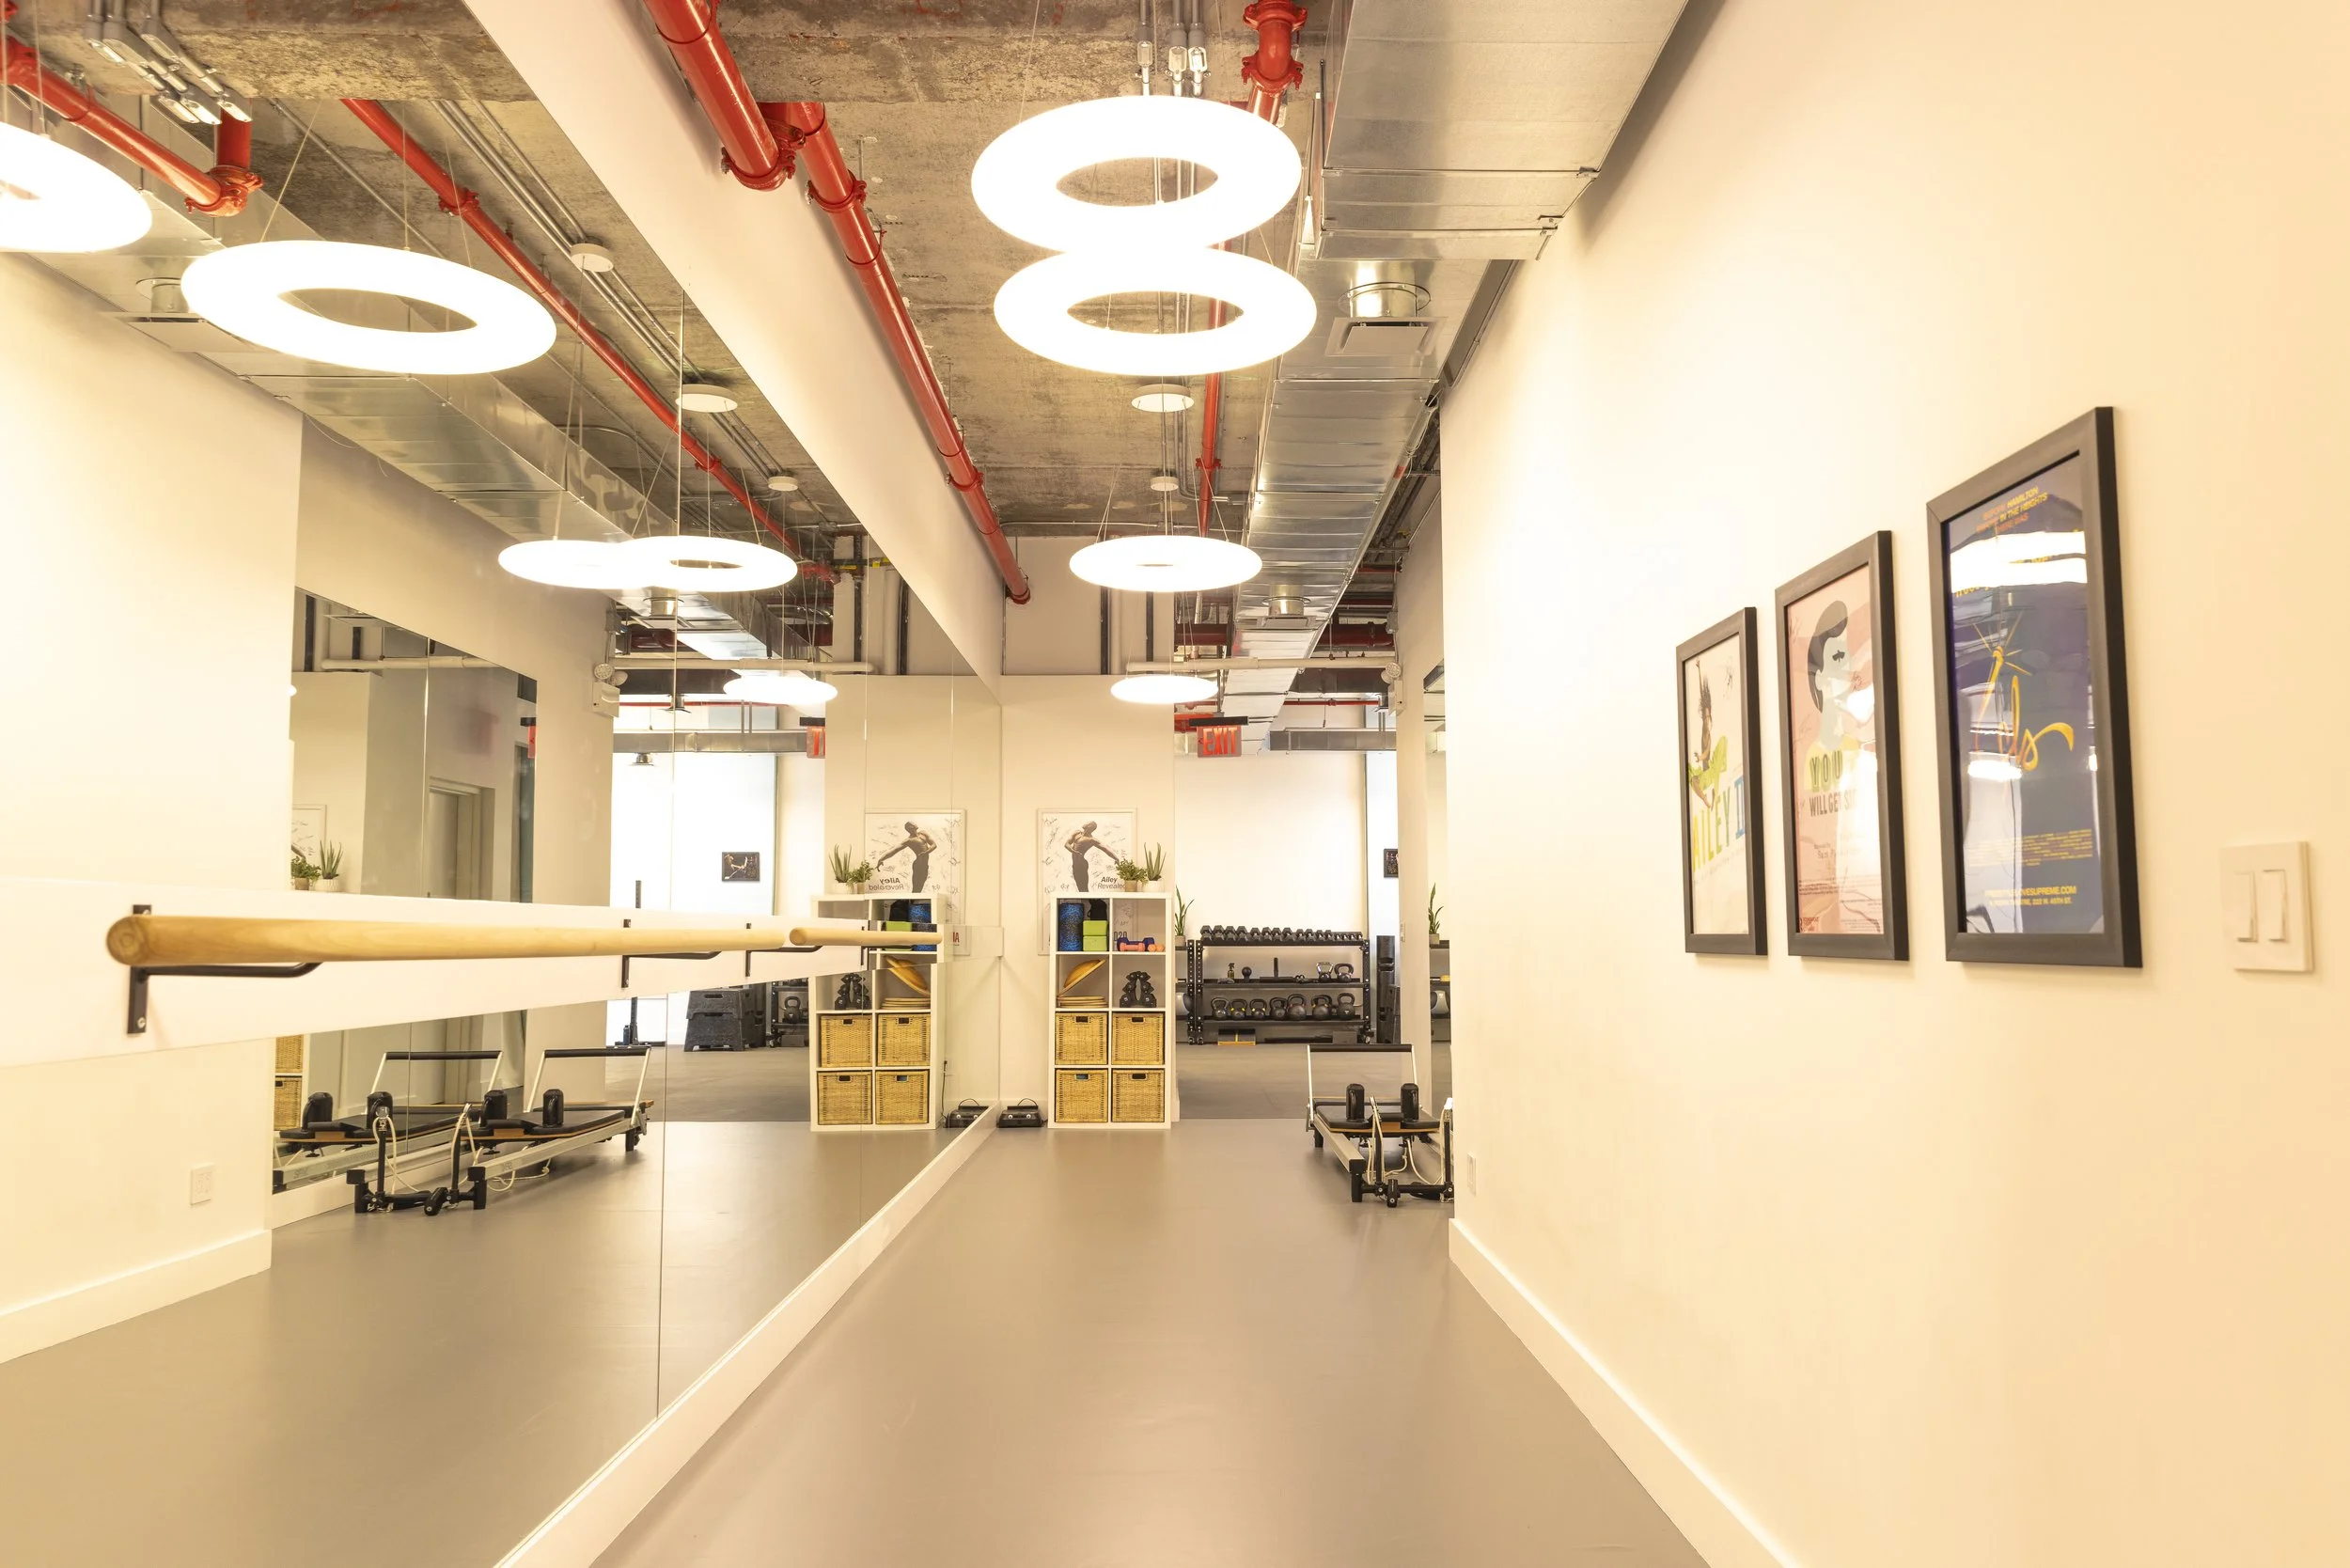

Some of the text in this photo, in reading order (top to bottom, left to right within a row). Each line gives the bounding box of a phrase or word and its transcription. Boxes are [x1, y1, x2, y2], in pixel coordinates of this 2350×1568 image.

[2008, 487, 2038, 507] HAMILTON
[2020, 493, 2047, 512] HEIGHTS
[1203, 727, 1238, 756] EXIT
[1810, 749, 1843, 792] YOU
[1809, 794, 1827, 817] WILL
[1693, 786, 1731, 873] AILEY
